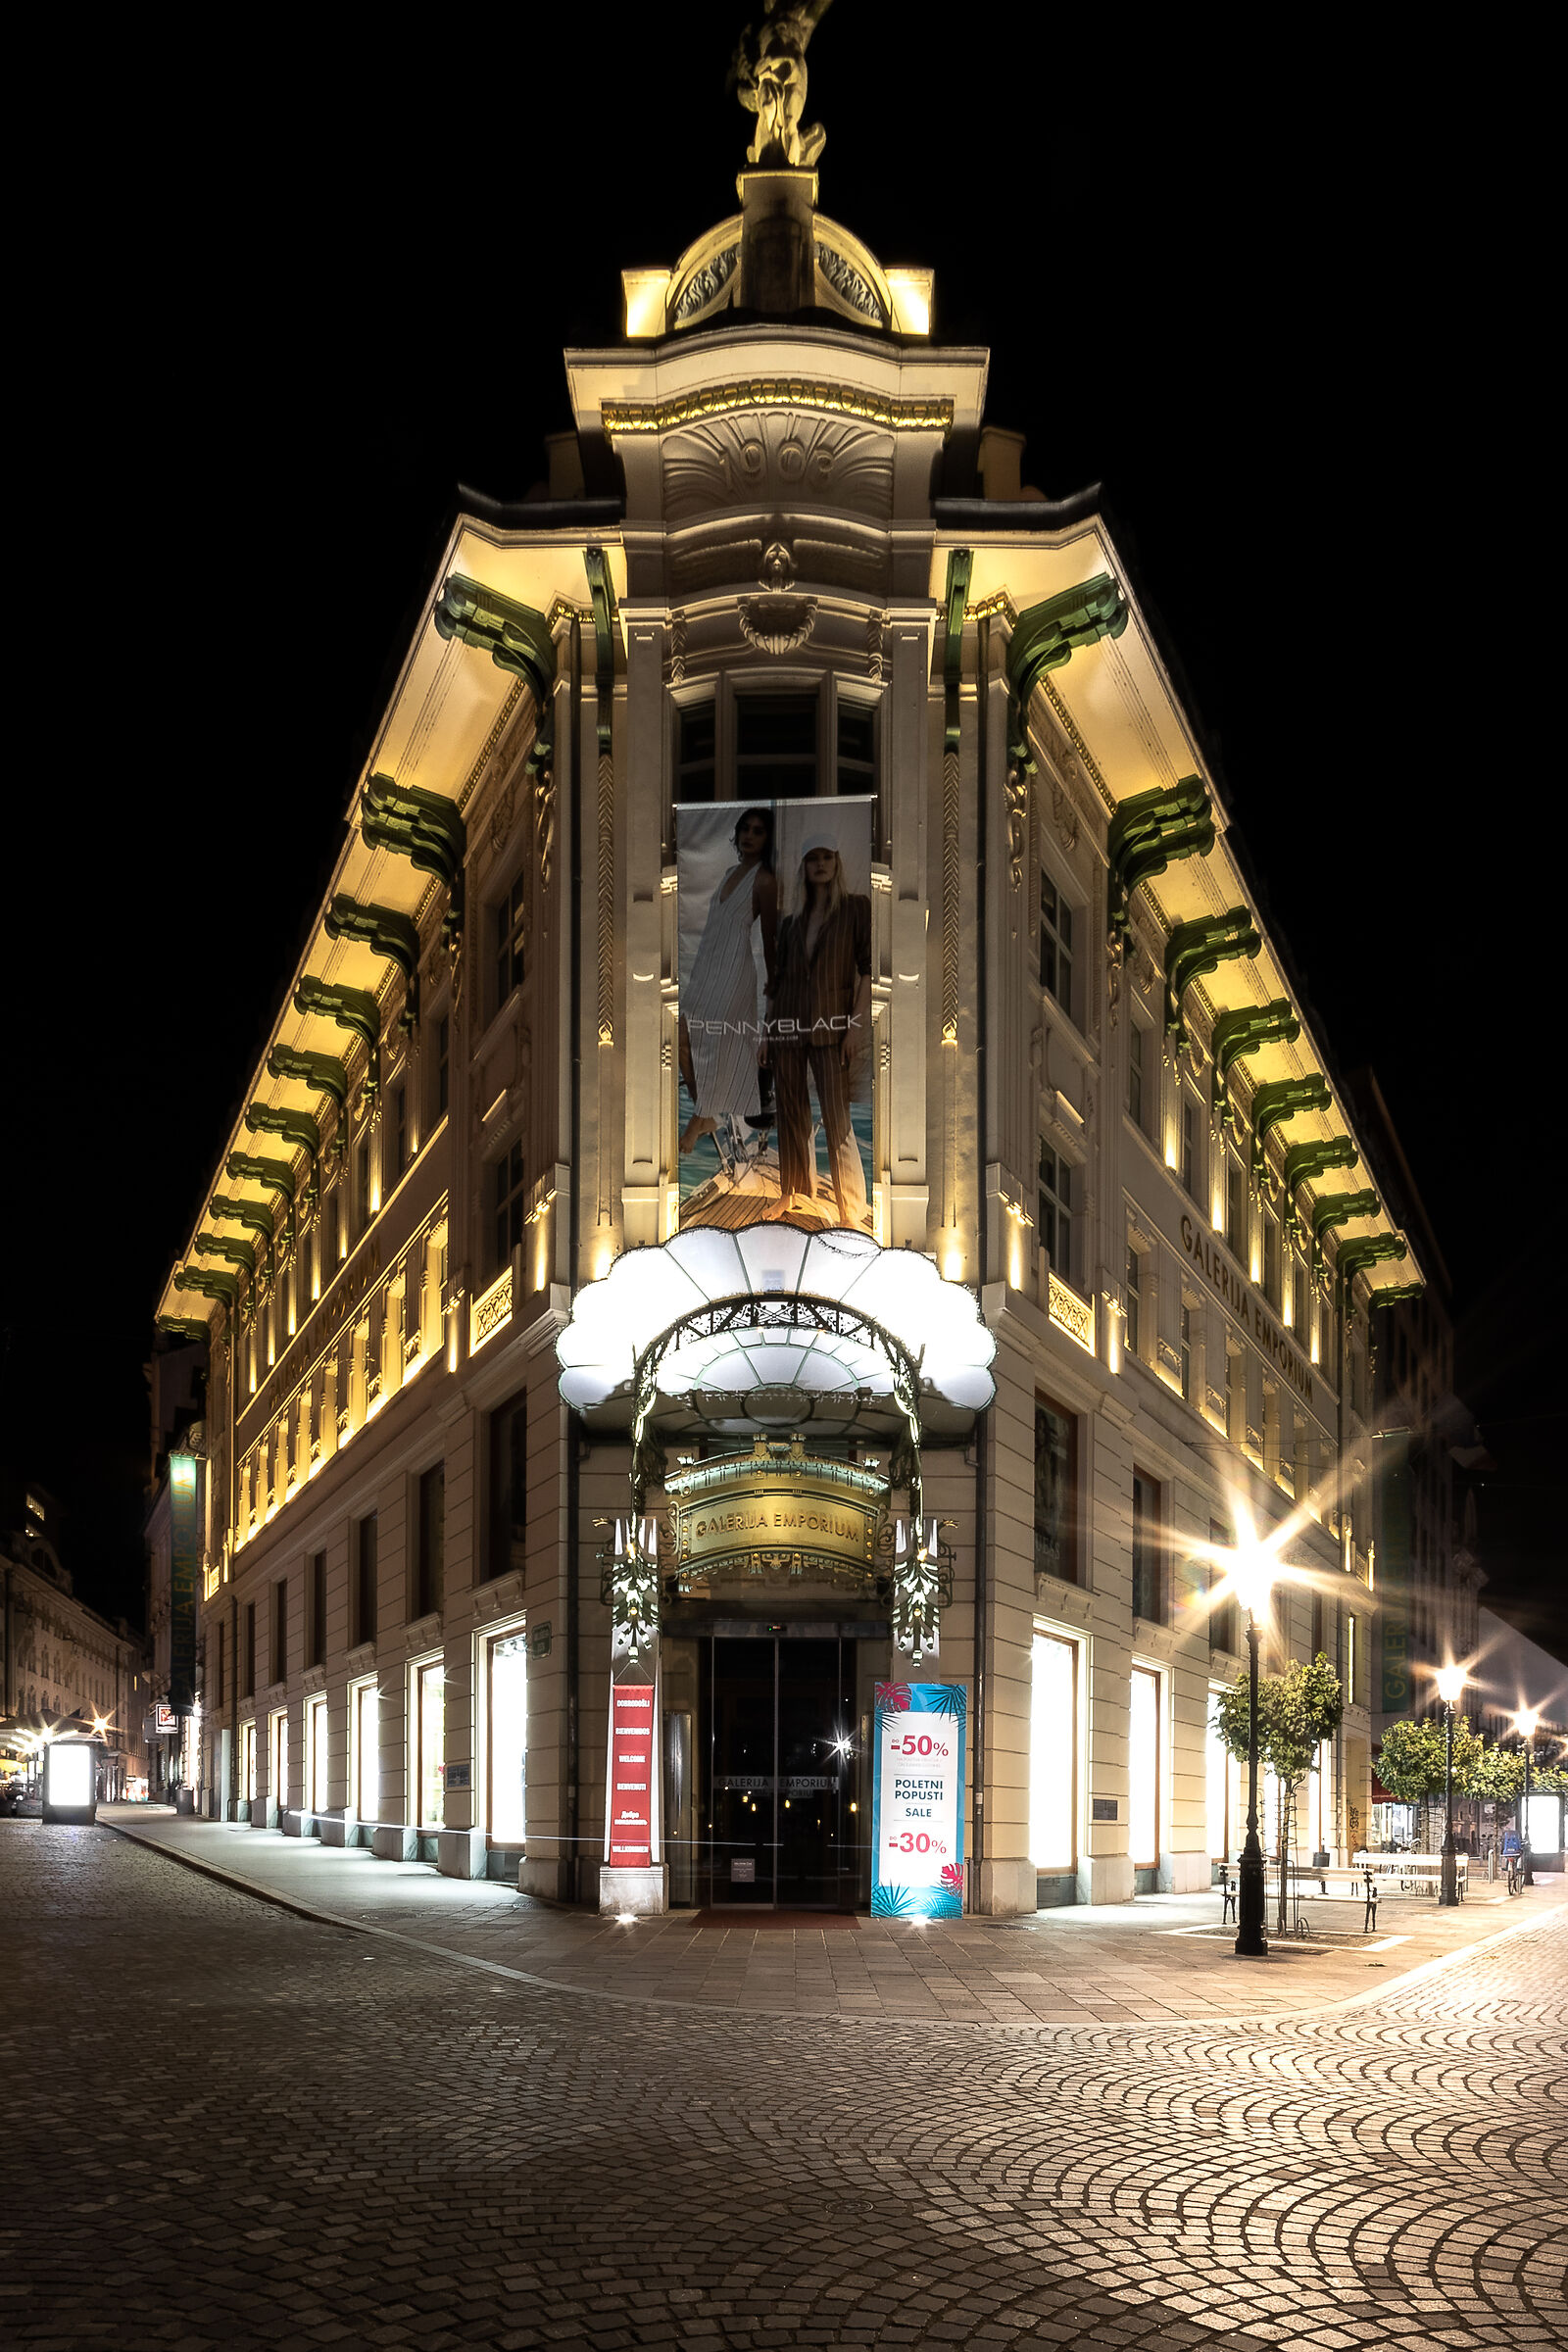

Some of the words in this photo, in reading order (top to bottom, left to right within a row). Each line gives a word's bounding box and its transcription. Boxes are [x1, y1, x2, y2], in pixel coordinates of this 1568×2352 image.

[686, 1013, 862, 1036] PENNYBLACK
[1180, 1214, 1250, 1326] GALERIJA
[1253, 1307, 1314, 1404] EMPORIUM
[695, 1512, 768, 1538] GALERIJA
[773, 1512, 858, 1542] EMPORIUM
[718, 1778, 769, 1788] GALERIJA
[780, 1778, 837, 1788] EMPORIUM
[895, 1779, 944, 1789] POLETNI
[895, 1790, 944, 1801] POPUSTI
[905, 1807, 932, 1818] SALE
